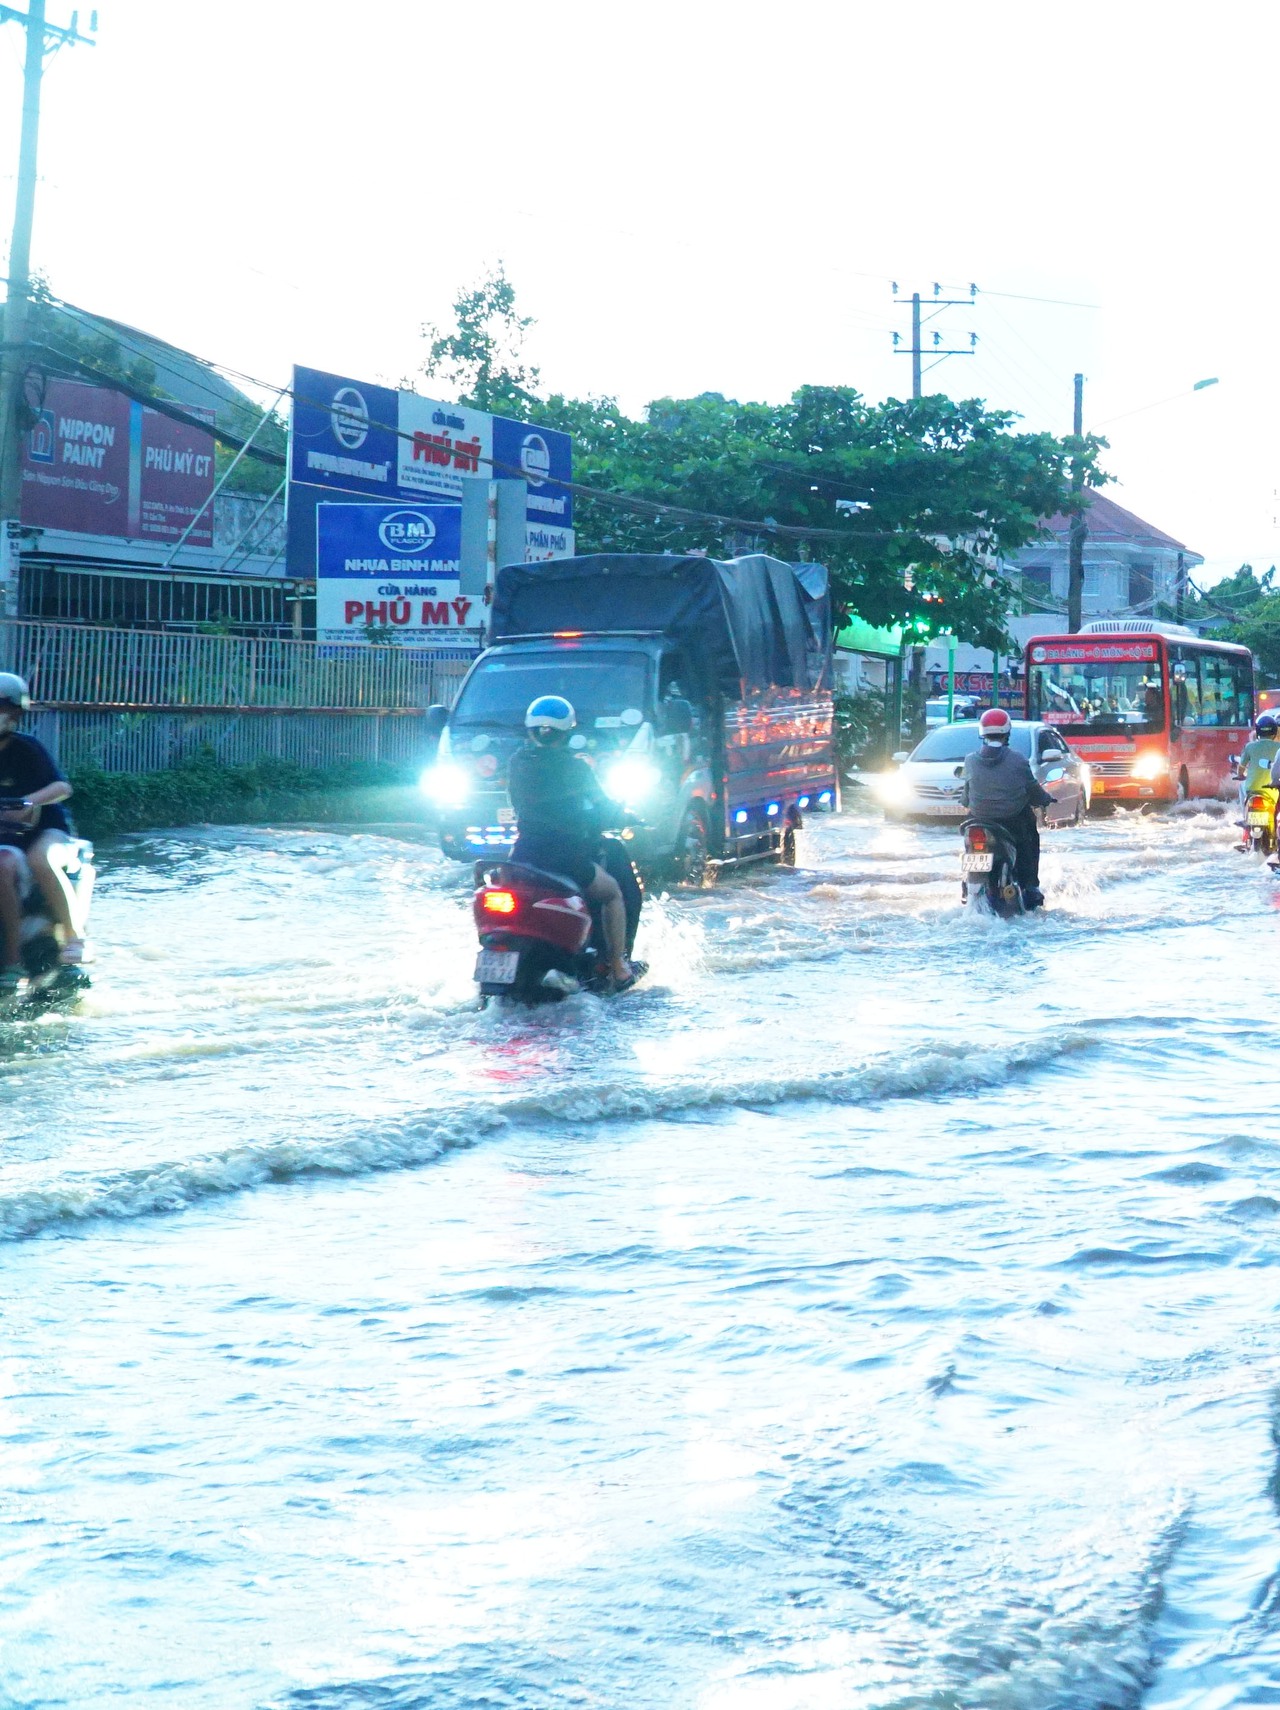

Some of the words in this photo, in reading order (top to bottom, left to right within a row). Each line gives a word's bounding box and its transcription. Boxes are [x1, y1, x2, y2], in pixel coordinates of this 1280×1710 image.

[59, 417, 115, 447] NIPPON
[62, 442, 106, 468] PAINT
[145, 445, 172, 472] PHÚ
[174, 448, 194, 475] MỸ
[195, 454, 212, 478] CT
[390, 522, 426, 538] BM
[344, 559, 389, 575] NHỰA
[377, 583, 401, 596] CỬA
[404, 583, 437, 596] HÀNG
[344, 596, 412, 625] PHÚ
[421, 597, 472, 625] MỸ
